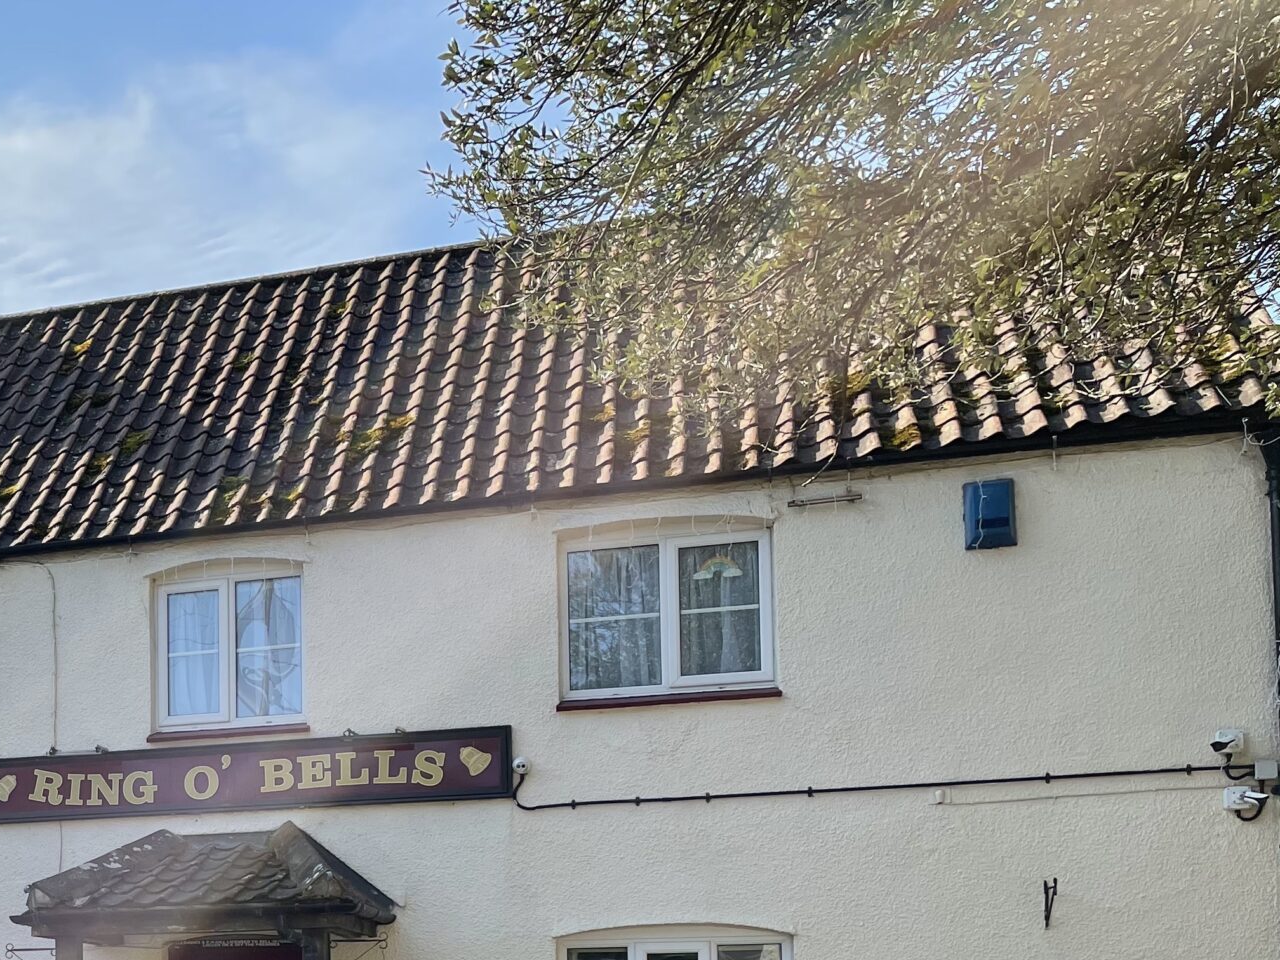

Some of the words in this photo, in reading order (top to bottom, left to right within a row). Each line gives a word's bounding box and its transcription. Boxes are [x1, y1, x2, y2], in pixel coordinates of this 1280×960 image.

[28, 767, 157, 806] RING
[184, 754, 232, 801] O'
[260, 749, 447, 793] BELLS
